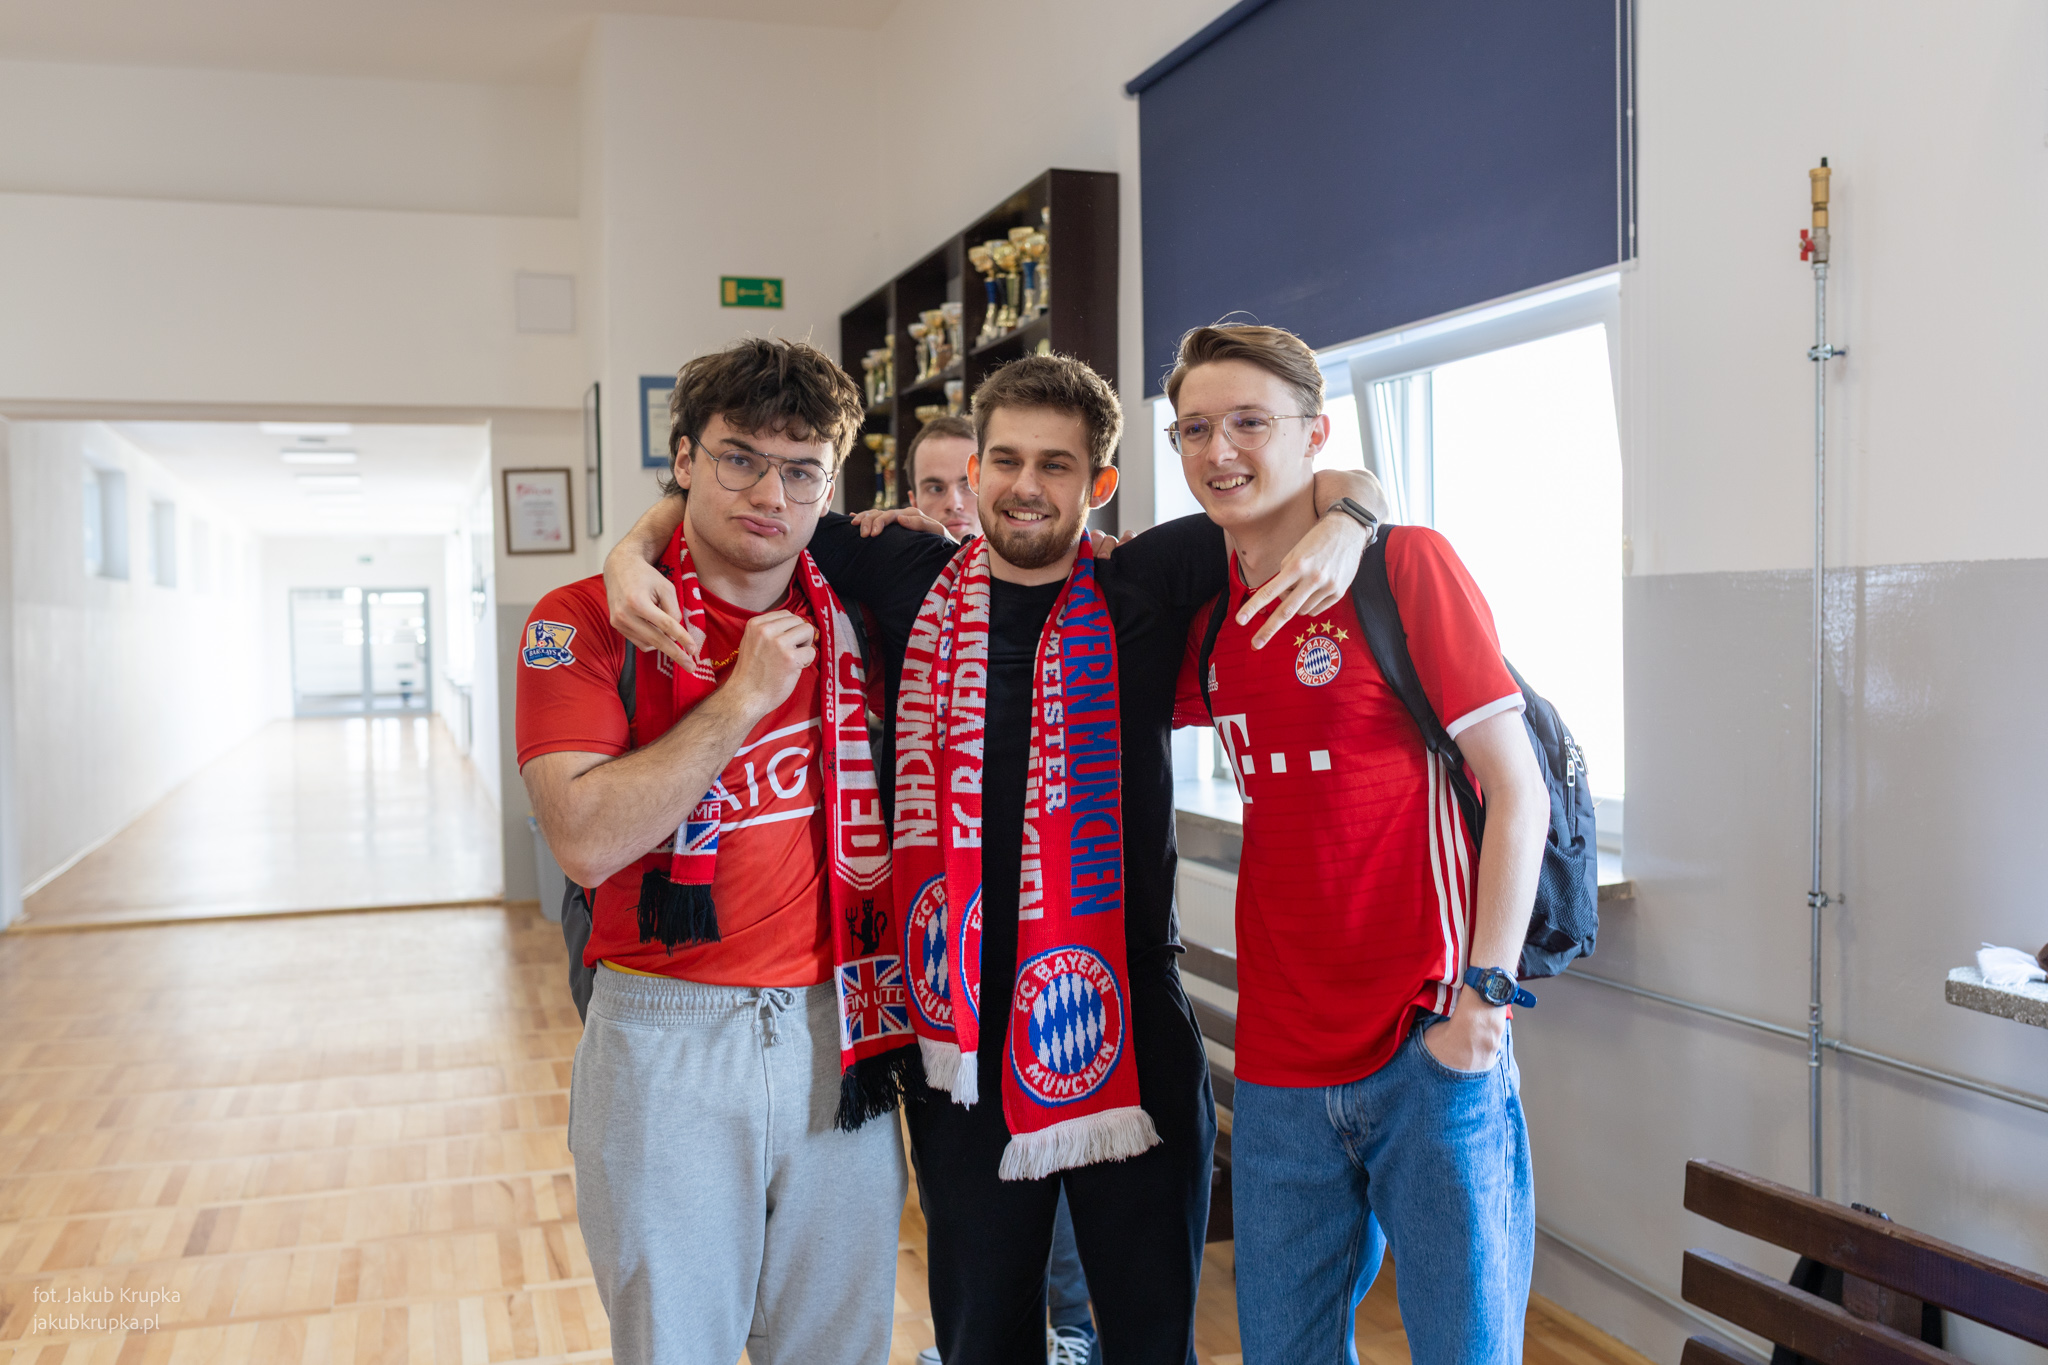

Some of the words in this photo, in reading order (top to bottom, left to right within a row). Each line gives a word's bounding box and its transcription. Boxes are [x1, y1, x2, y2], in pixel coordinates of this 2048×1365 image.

[1306, 639, 1339, 660] BAYERN
[838, 653, 889, 858] UNITED
[893, 658, 938, 849] MÜNCHEN
[1067, 720, 1121, 917] MÜNCHEN
[915, 898, 933, 929] FC
[1015, 979, 1038, 1013] FC
[1033, 953, 1112, 995] BAYERN
[1025, 1041, 1116, 1095] MÜNCHEN
